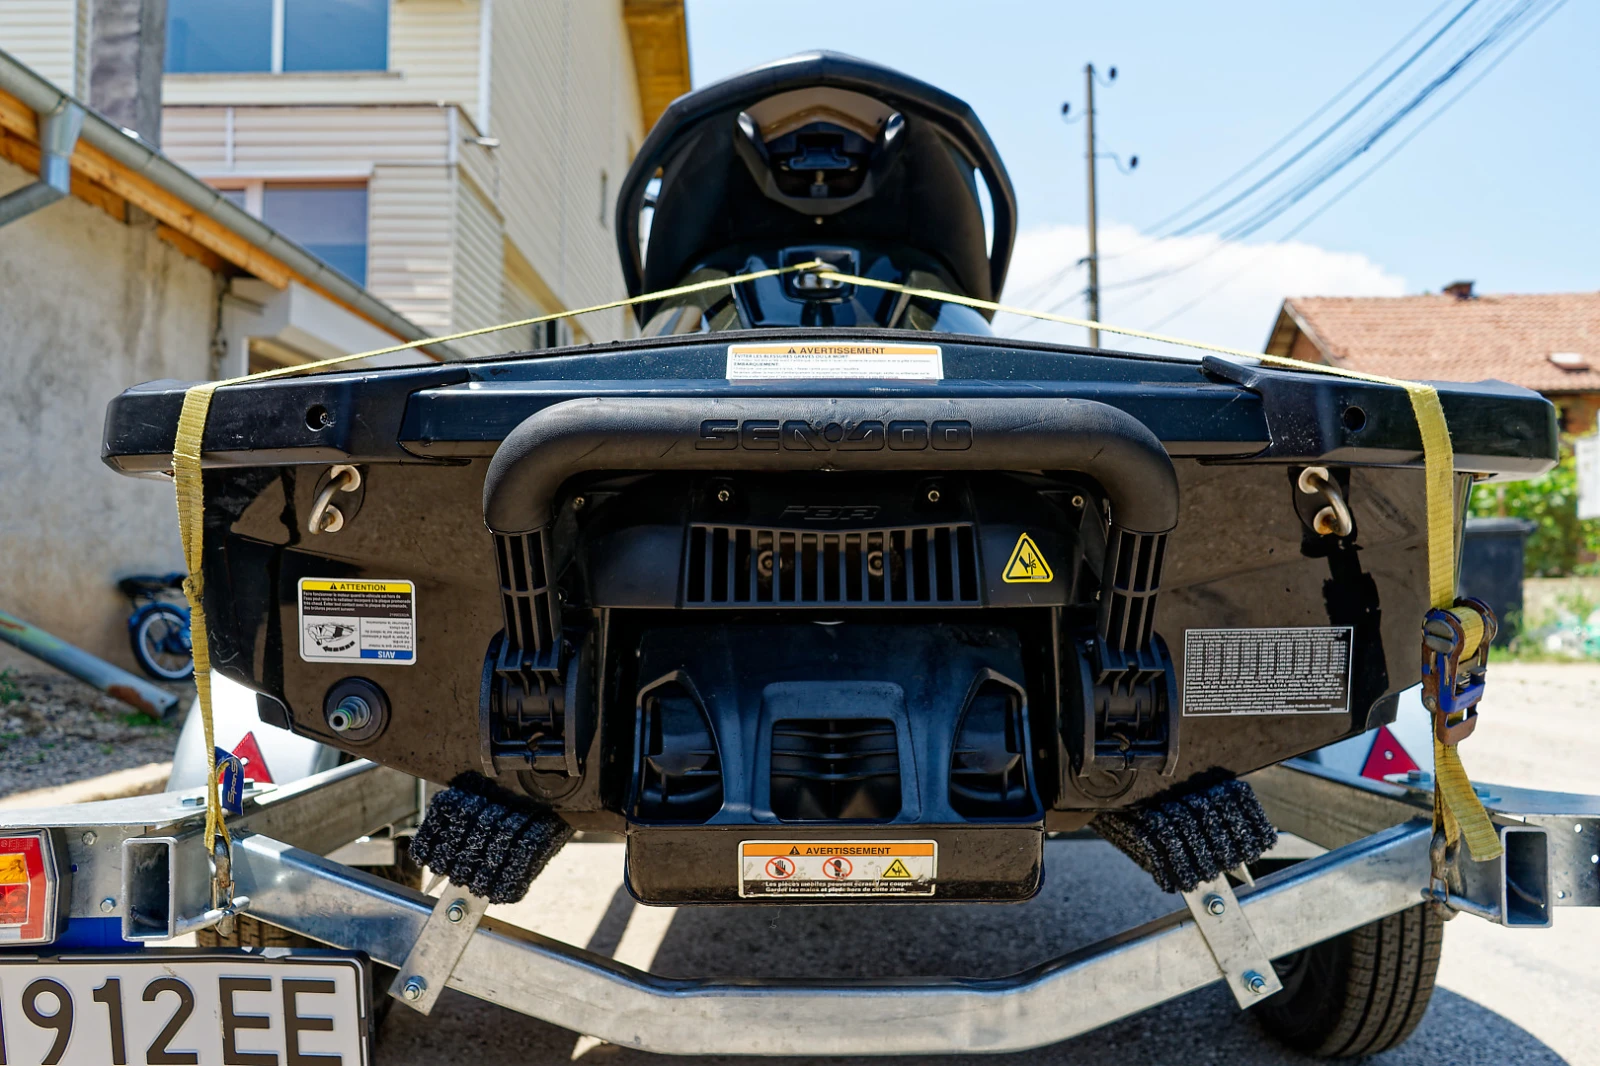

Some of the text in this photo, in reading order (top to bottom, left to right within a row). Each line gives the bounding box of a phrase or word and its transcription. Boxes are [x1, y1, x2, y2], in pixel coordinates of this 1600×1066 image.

[377, 651, 396, 659] AVIS
[805, 847, 891, 855] AVERTISSEMENT
[0, 976, 342, 1066] 912EE
